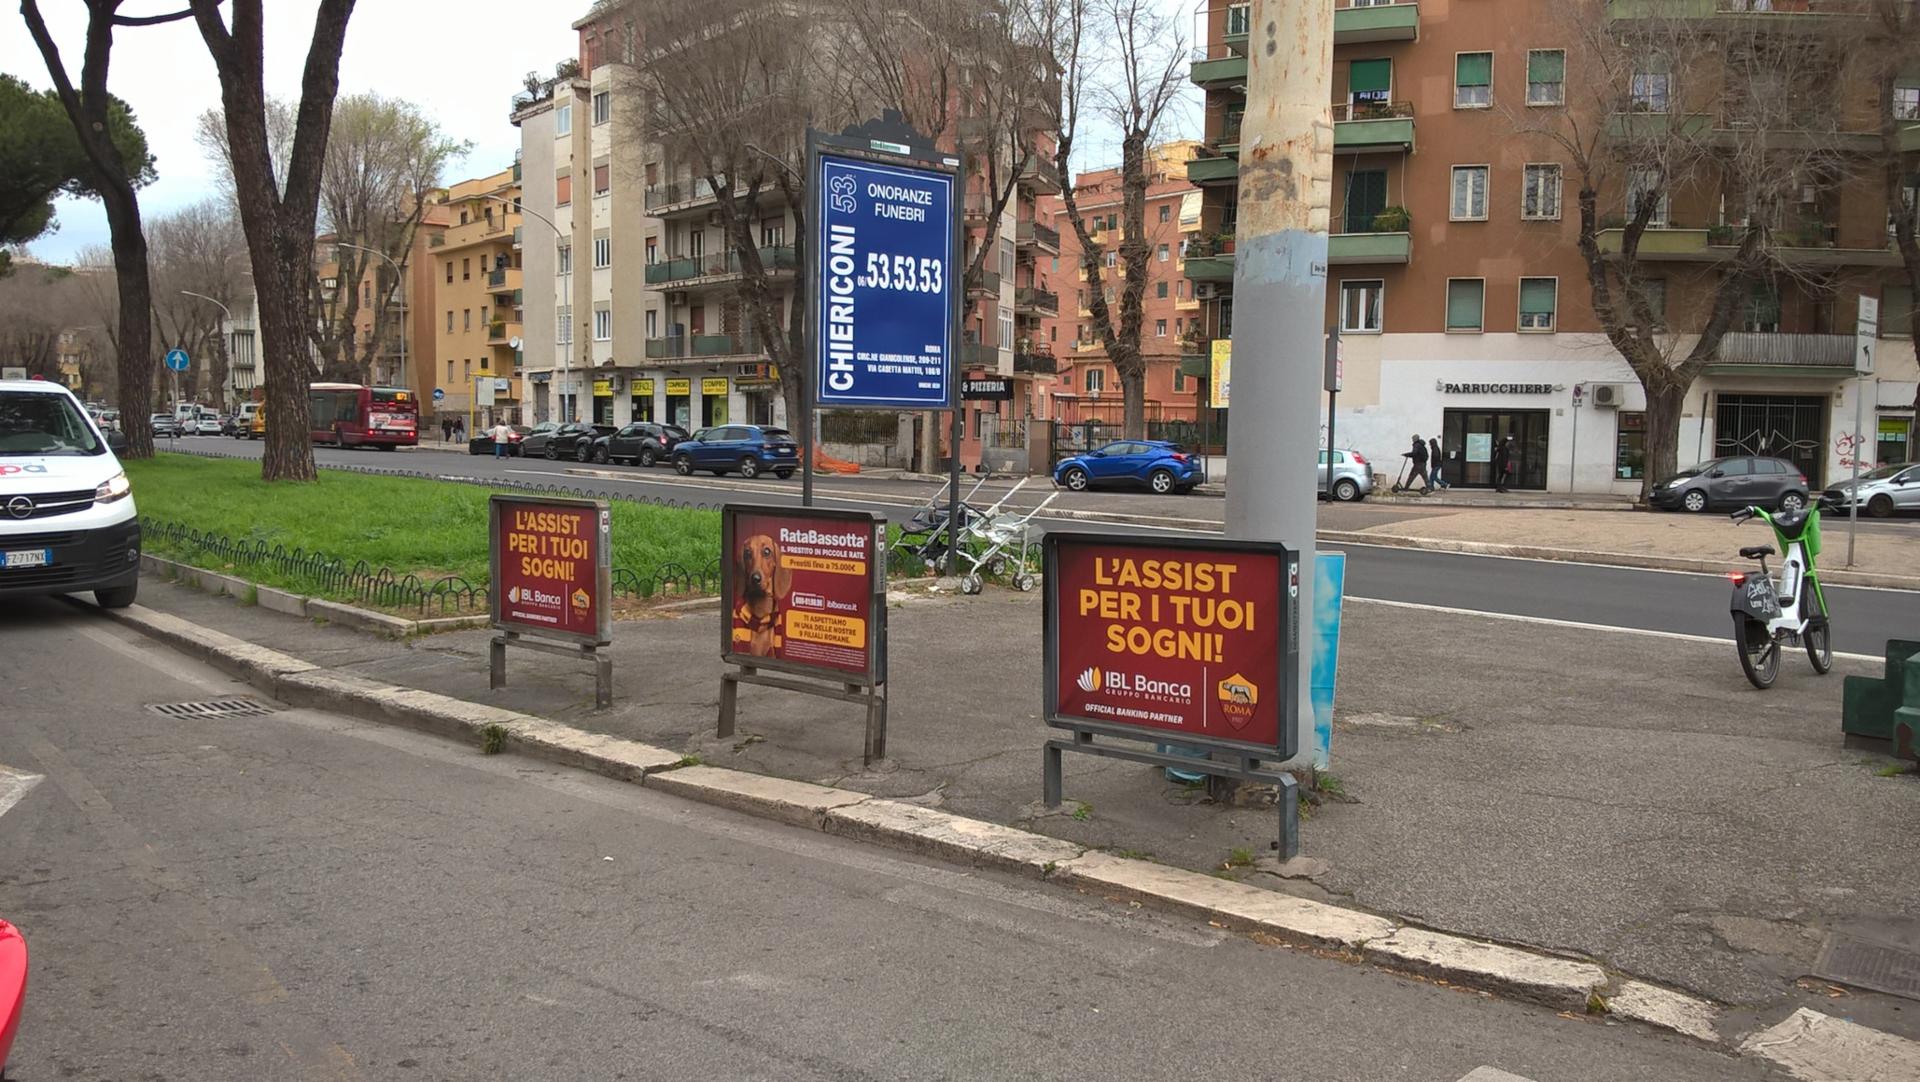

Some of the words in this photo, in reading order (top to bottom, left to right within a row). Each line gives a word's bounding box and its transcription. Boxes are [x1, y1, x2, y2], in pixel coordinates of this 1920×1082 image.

[830, 174, 857, 214] 53
[868, 183, 932, 206] ONORANZE
[875, 203, 925, 222] FUNEBRI
[829, 224, 856, 391] CHIERICONI
[867, 364, 877, 372] VIA
[962, 381, 969, 392] &
[970, 381, 1005, 392] PIZZERIA
[1444, 383, 1553, 395] PARRUCCHIERE
[516, 510, 580, 536] L'ASSIST
[509, 533, 537, 554] PER
[542, 537, 546, 555] I
[550, 537, 588, 560] TUOI
[787, 546, 814, 555] PRESTITO
[822, 549, 847, 557] PICCOLE
[848, 551, 865, 559] RATE.
[521, 556, 575, 582] SOGNI!
[789, 559, 811, 568] Prestiti
[1095, 557, 1237, 594] L'ASSIST
[521, 588, 533, 602] IBL
[535, 590, 561, 605] Banca
[1079, 589, 1142, 621] PER
[1151, 594, 1160, 622] I
[1169, 595, 1255, 631] TUOI
[810, 615, 847, 626] ASPETTIAMO
[814, 624, 832, 632] DELLE
[833, 627, 856, 636] NOSTRE
[804, 631, 823, 639] FILIALI
[1106, 624, 1224, 663] SOGNI!
[1105, 671, 1131, 690] IBL
[1135, 674, 1191, 697] Banca
[1105, 688, 1141, 698] GRUPPO
[1144, 692, 1192, 705] BANCARIO
[1085, 703, 1116, 715] OFFICIAL
[1116, 707, 1149, 719] BANKING
[1149, 711, 1184, 725] PARTNER
[1223, 704, 1252, 716] ROMA
